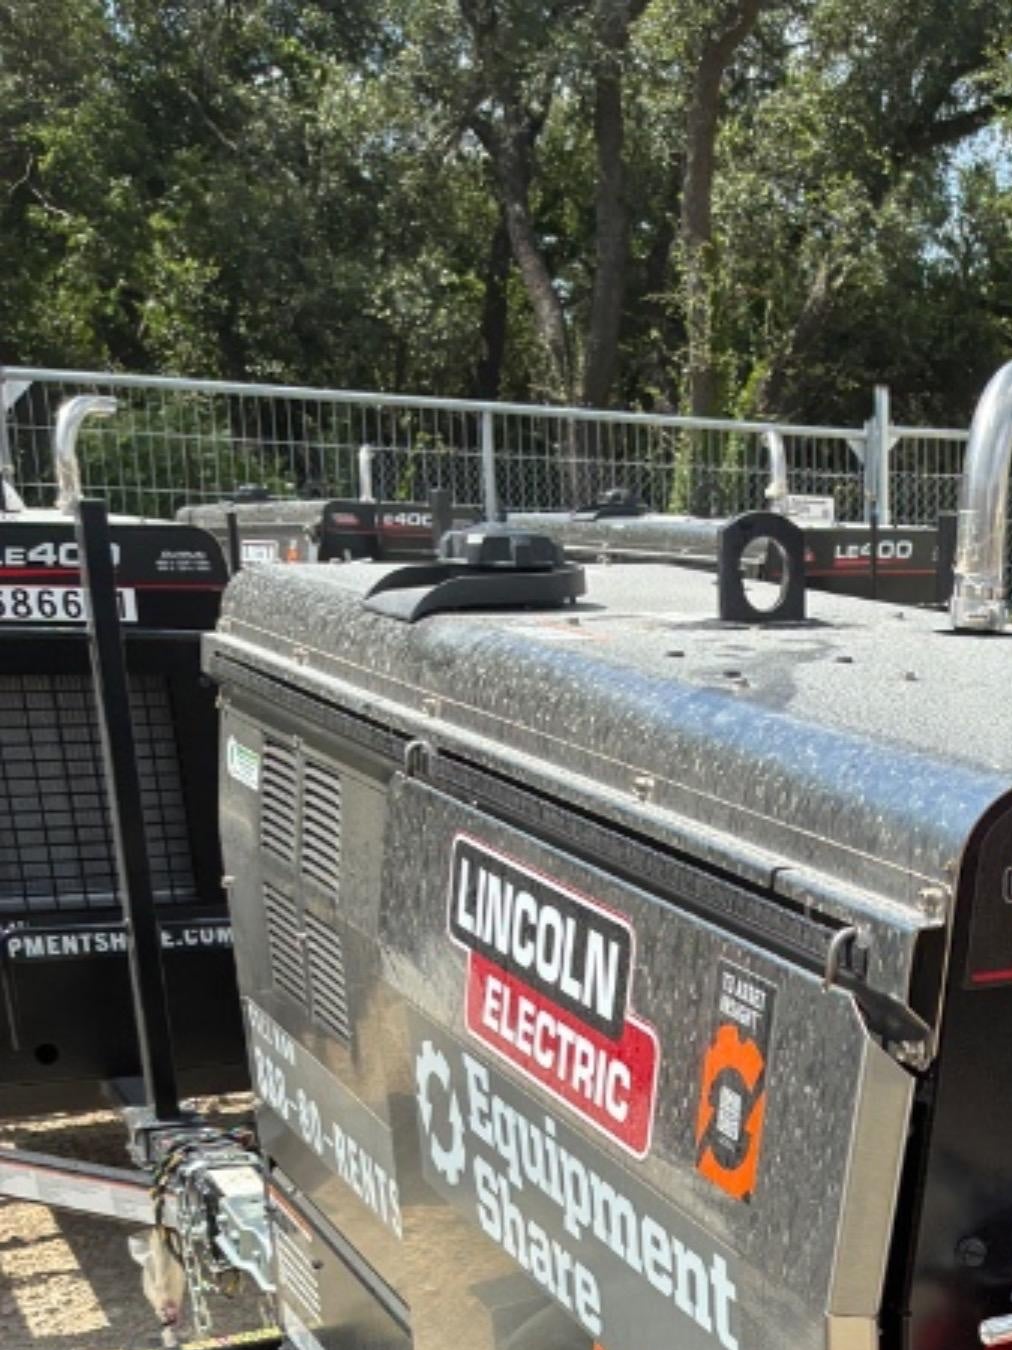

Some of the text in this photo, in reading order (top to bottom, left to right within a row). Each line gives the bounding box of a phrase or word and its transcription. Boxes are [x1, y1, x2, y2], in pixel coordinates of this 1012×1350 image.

[457, 857, 619, 1021] LINCOLN
[482, 974, 631, 1123] ELECTRIC
[473, 1154, 602, 1336] Share
